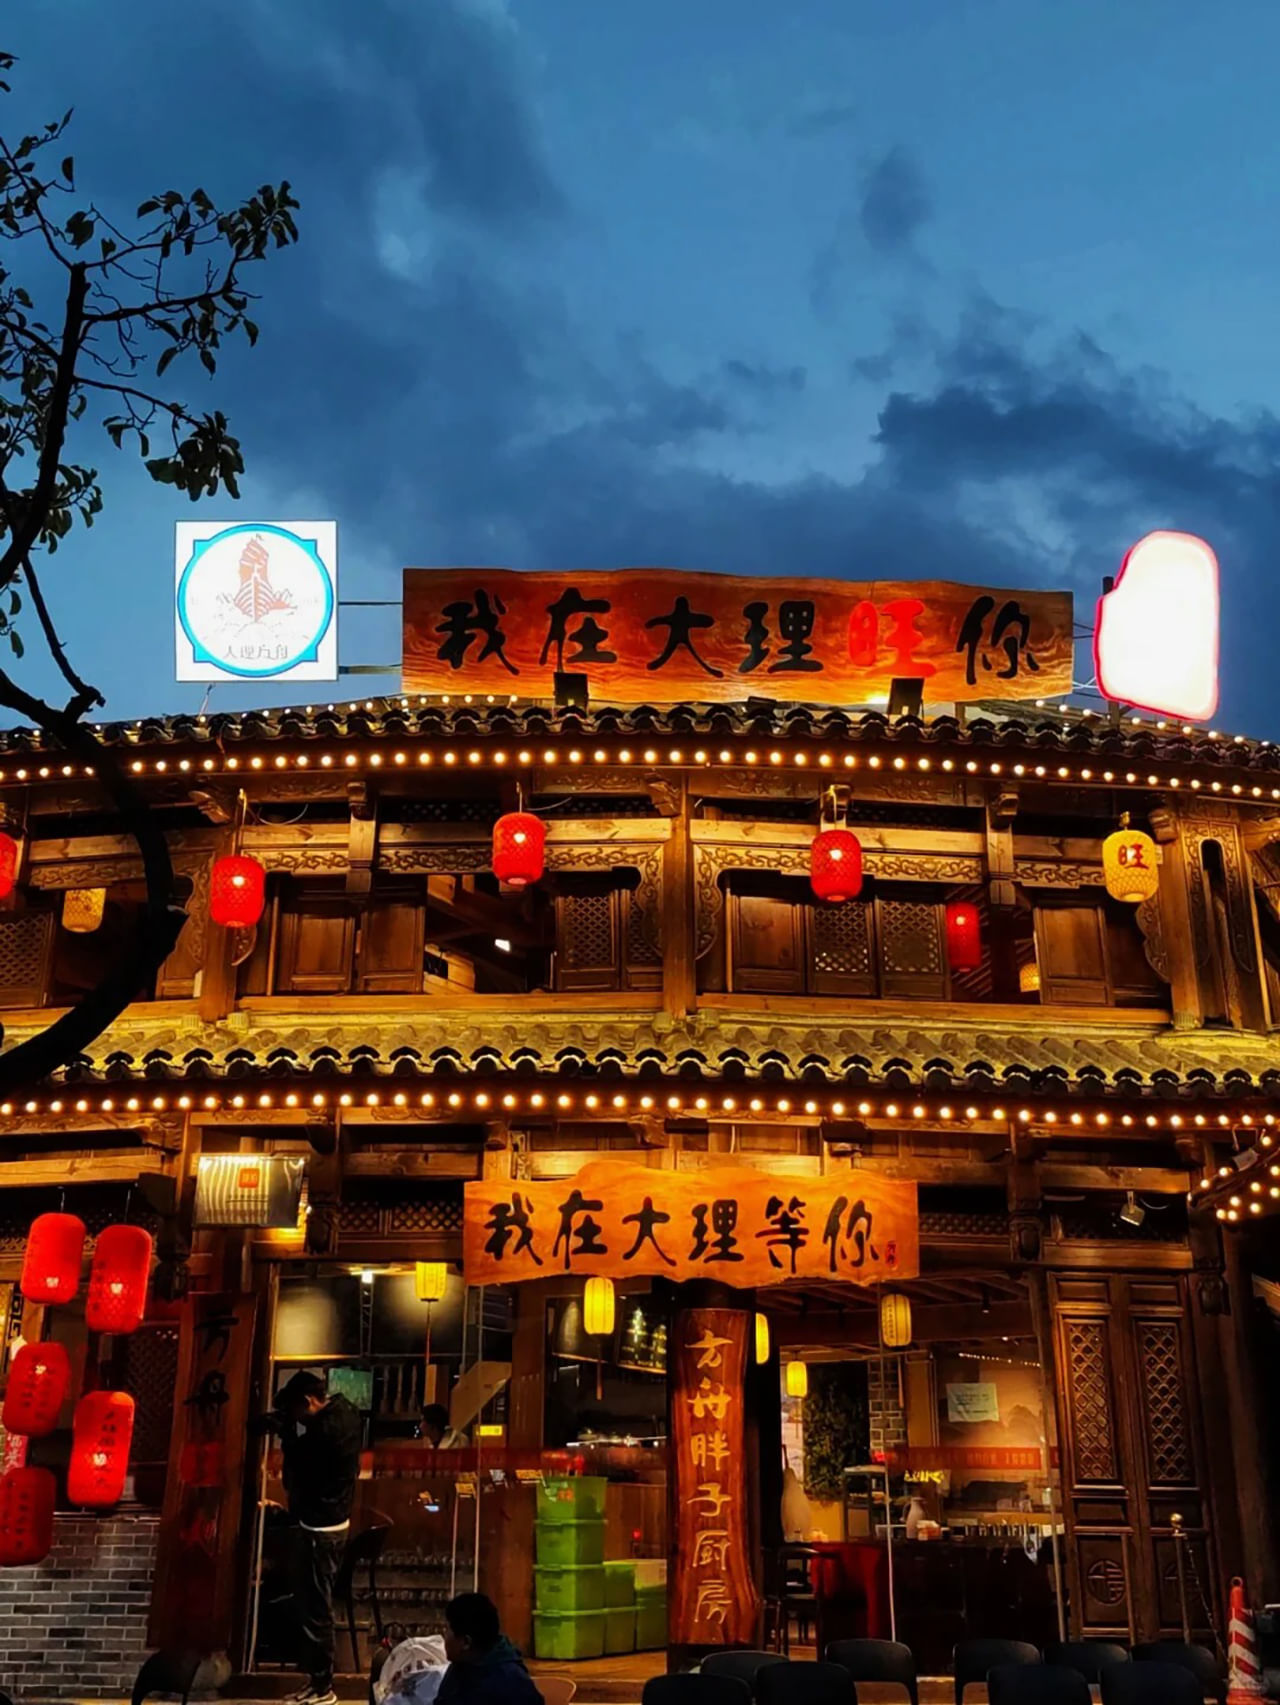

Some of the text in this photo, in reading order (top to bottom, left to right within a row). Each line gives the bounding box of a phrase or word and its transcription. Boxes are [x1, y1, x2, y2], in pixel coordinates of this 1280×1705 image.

[436, 588, 1040, 685] 我在大理旺你
[1117, 843, 1149, 870] 旺
[484, 1189, 880, 1274] 我在大理等你
